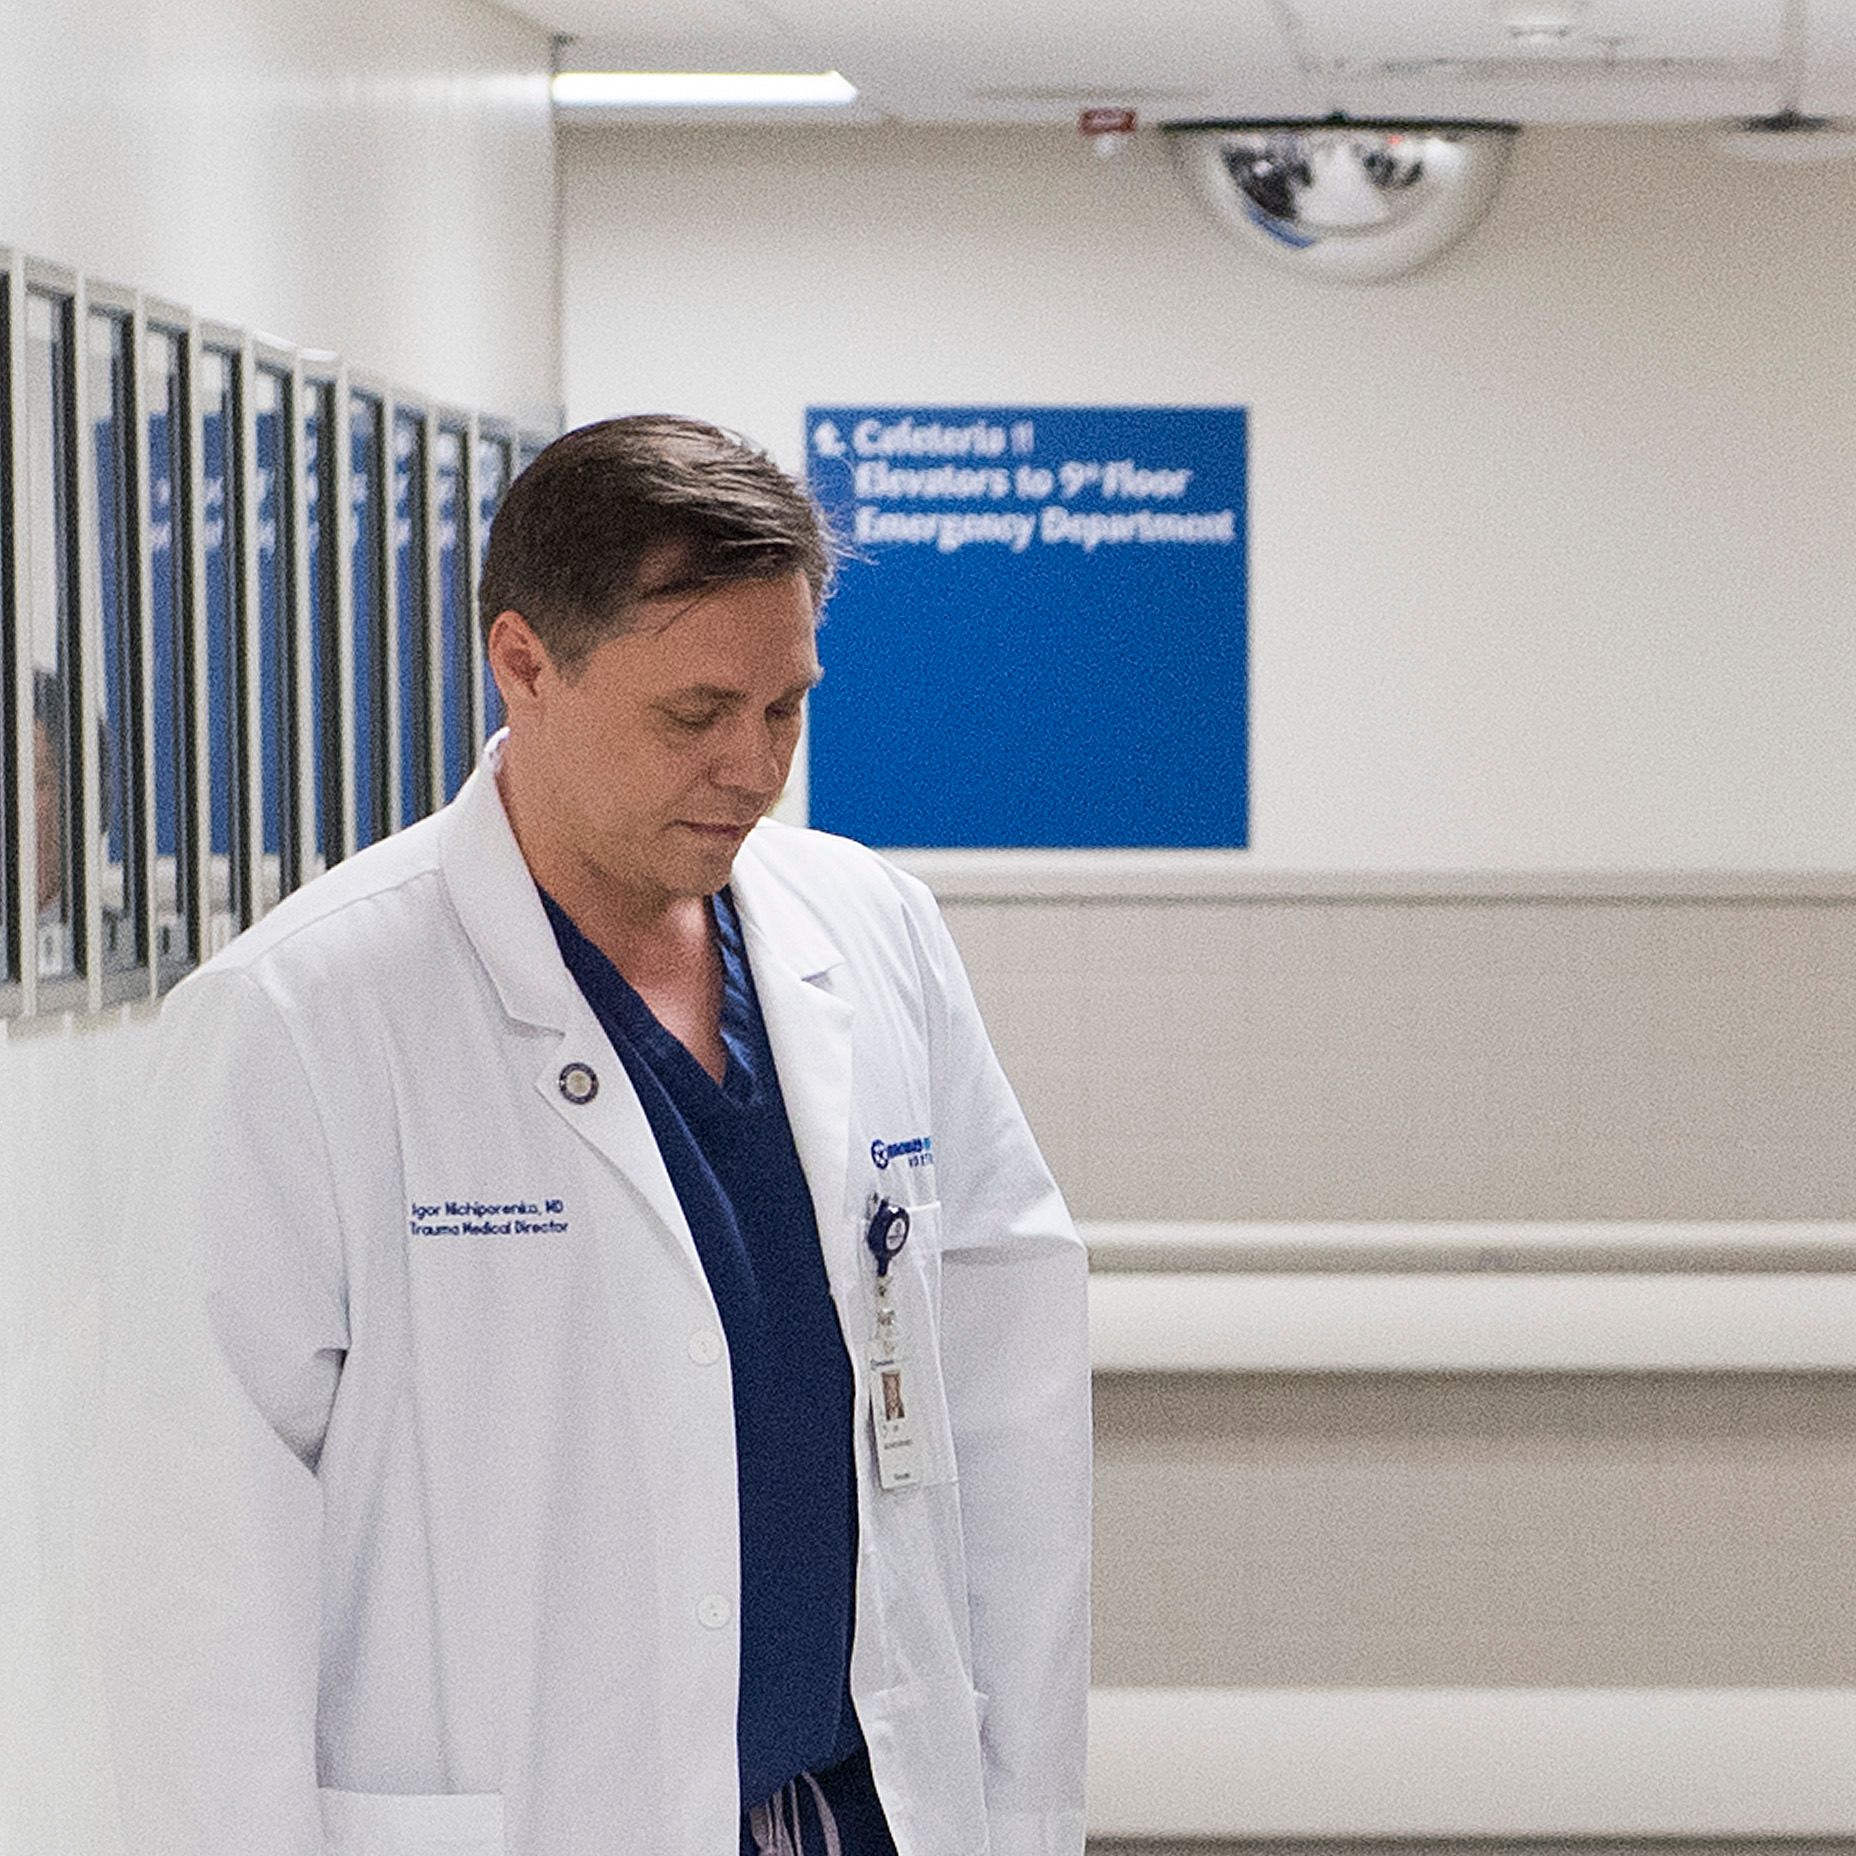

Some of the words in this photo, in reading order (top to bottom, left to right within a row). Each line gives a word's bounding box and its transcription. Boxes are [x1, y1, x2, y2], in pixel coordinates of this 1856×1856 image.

[1014, 464, 1053, 498] to
[1101, 458, 1192, 498] Floor
[854, 506, 1036, 553] Emergency
[1041, 505, 1236, 553] Department
[411, 1202, 441, 1220] Igor
[410, 1221, 460, 1236] Trauma
[462, 1221, 512, 1236] Medical
[514, 1219, 569, 1235] Director
